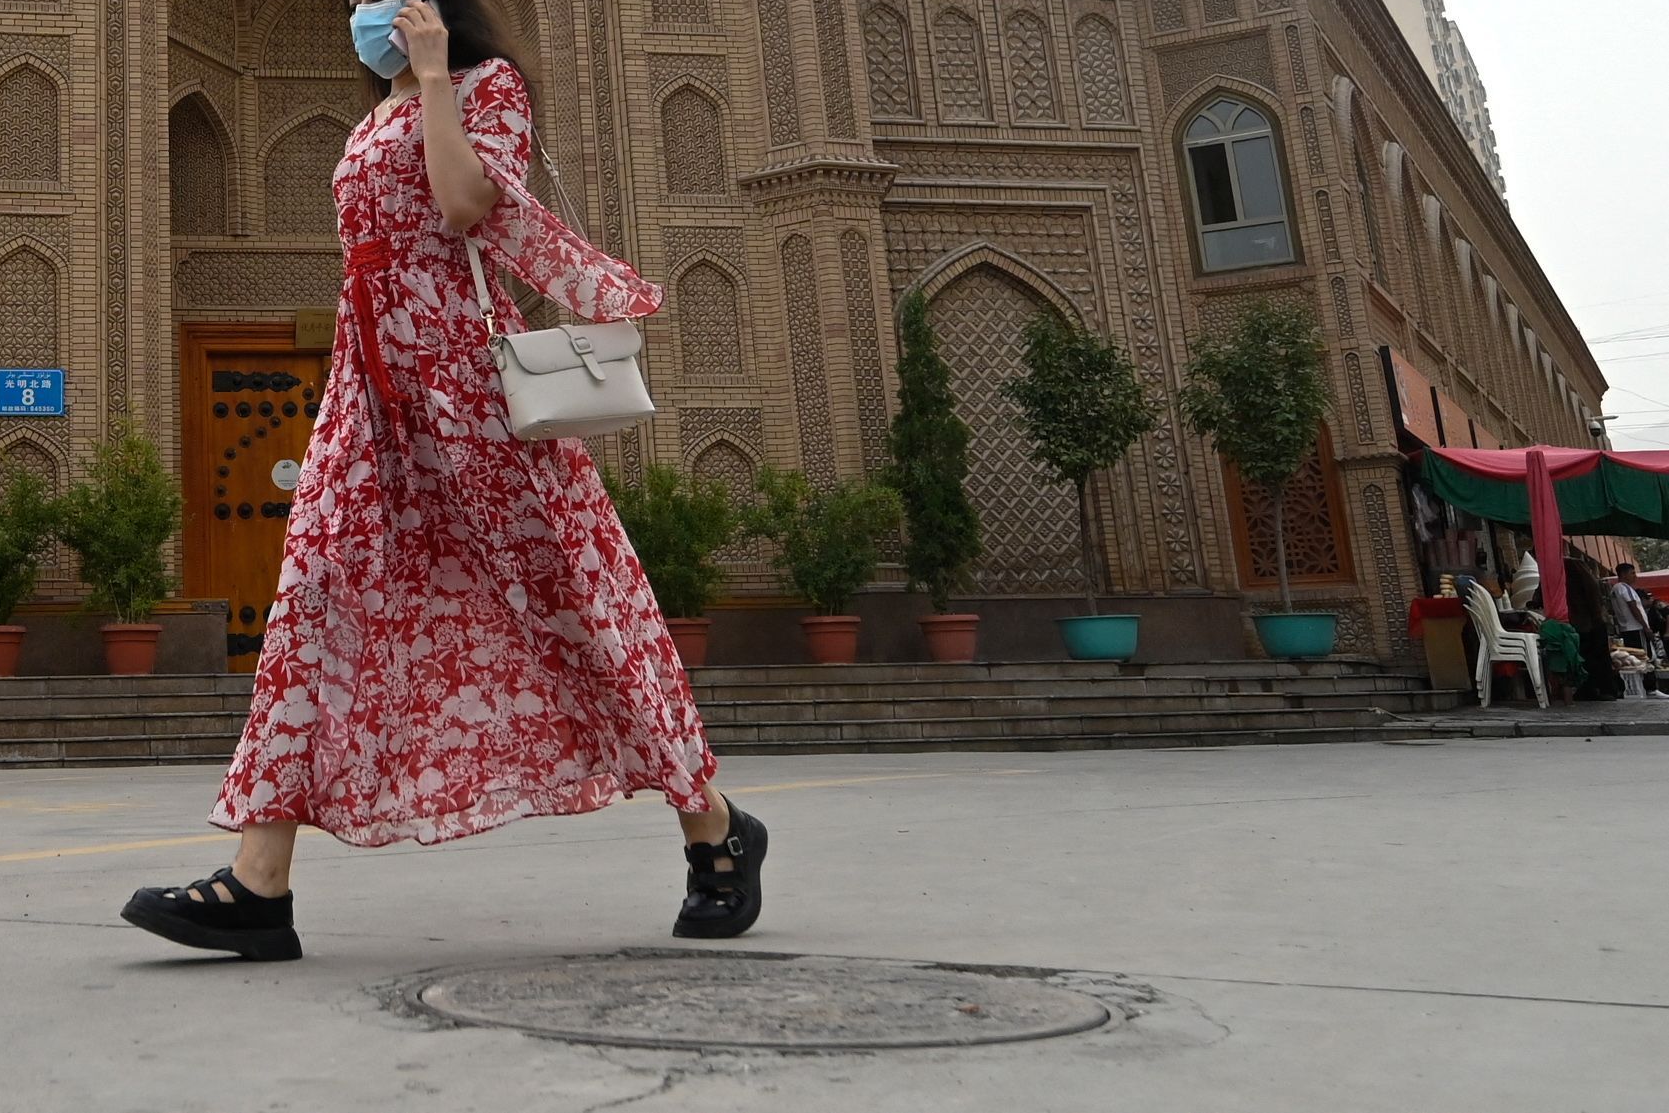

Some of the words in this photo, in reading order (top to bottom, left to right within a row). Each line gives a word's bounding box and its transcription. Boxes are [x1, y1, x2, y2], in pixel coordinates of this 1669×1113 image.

[4, 379, 52, 389] 光明北路
[21, 388, 35, 406] 8
